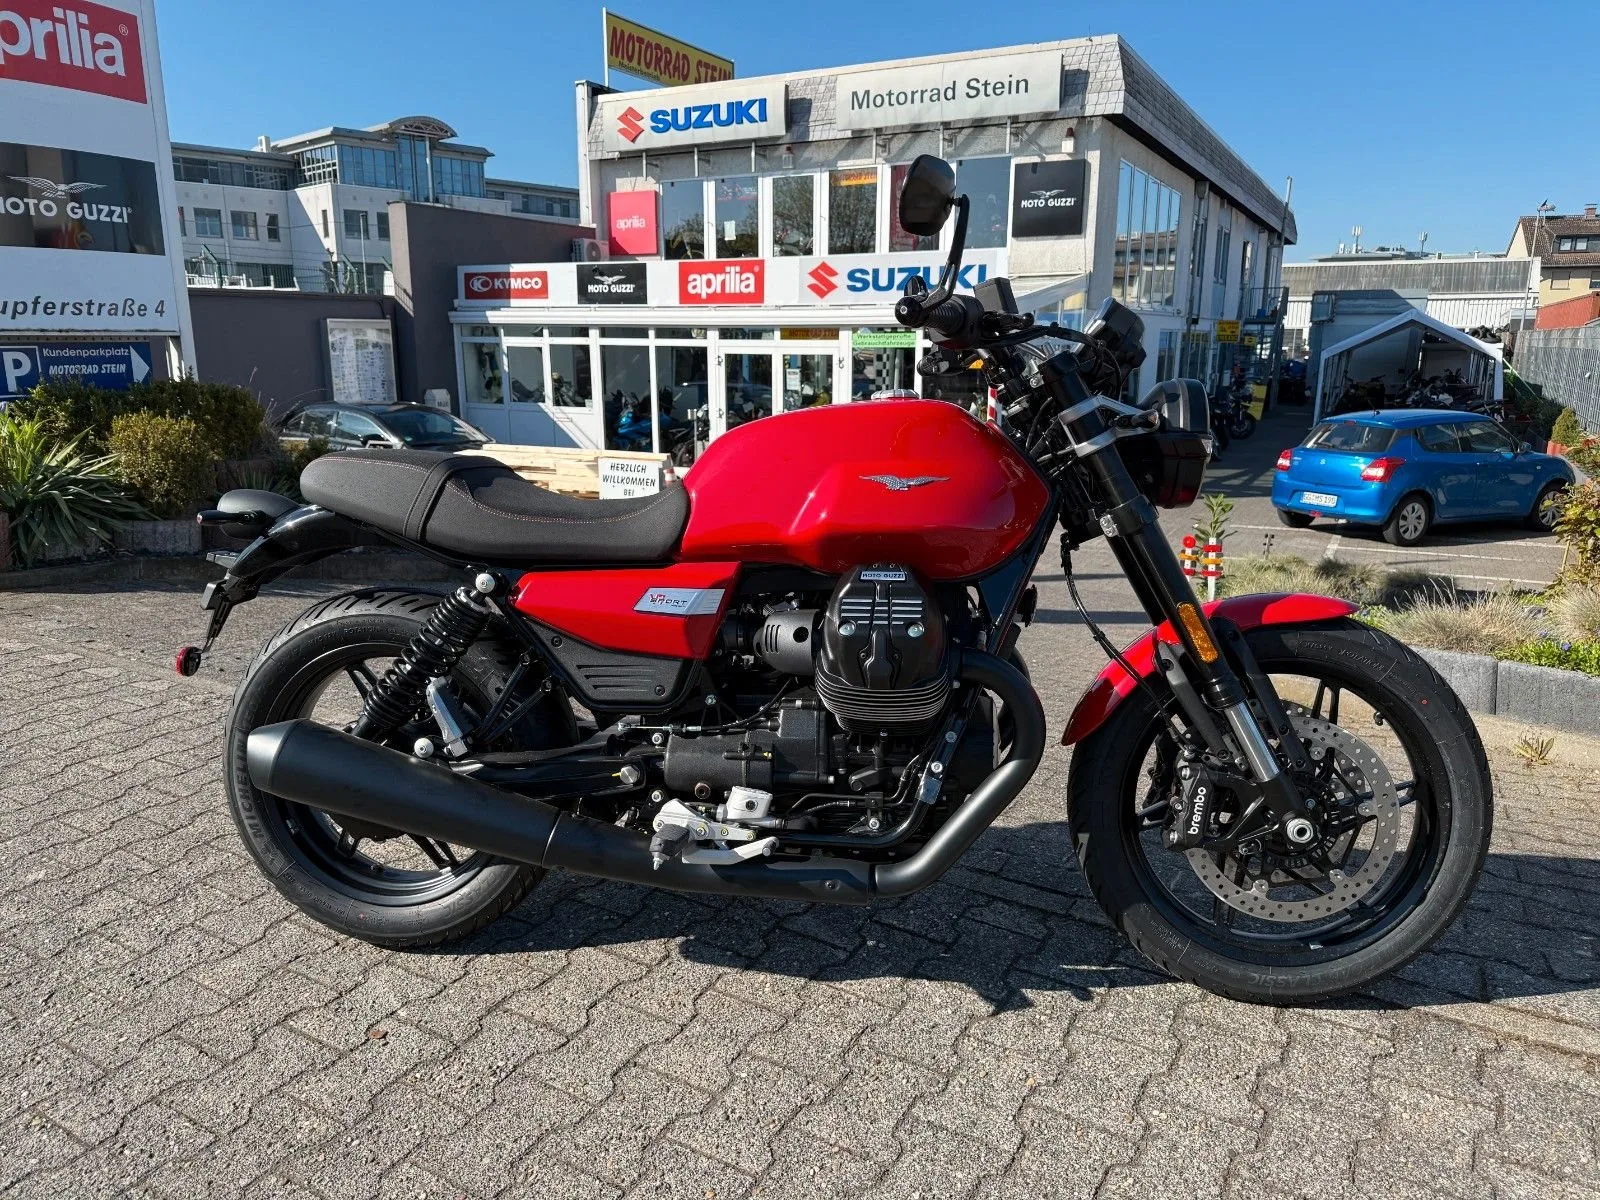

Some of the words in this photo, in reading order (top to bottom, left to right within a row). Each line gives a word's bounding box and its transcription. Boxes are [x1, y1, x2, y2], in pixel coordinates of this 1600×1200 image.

[0, 7, 126, 77] prilia
[610, 27, 690, 82] MOTORRAD
[851, 81, 956, 110] Motorrad
[965, 74, 1029, 99] Stein
[650, 98, 767, 133] SUZUKI
[66, 201, 129, 223] GUZZI
[1021, 199, 1045, 208] MOTO
[1048, 197, 1074, 207] GUZZI
[616, 215, 646, 231] aprilia
[494, 277, 542, 290] KYMCO
[587, 284, 609, 293] MOTO
[610, 284, 634, 293] GUZZI
[687, 266, 756, 301] aprilia
[846, 264, 987, 292] SUZUKI
[0, 295, 148, 320] upferstraße
[155, 299, 165, 317] 4
[42, 347, 130, 358] Kundenparkplatz
[49, 364, 99, 375] MOTORRAD
[101, 363, 126, 374] STEIN
[610, 462, 647, 474] HERZLICH
[602, 474, 656, 487] WILLKOMMEN
[623, 488, 635, 497] BEI
[233, 735, 264, 839] MICHELIN
[1187, 786, 1207, 835] brembo
